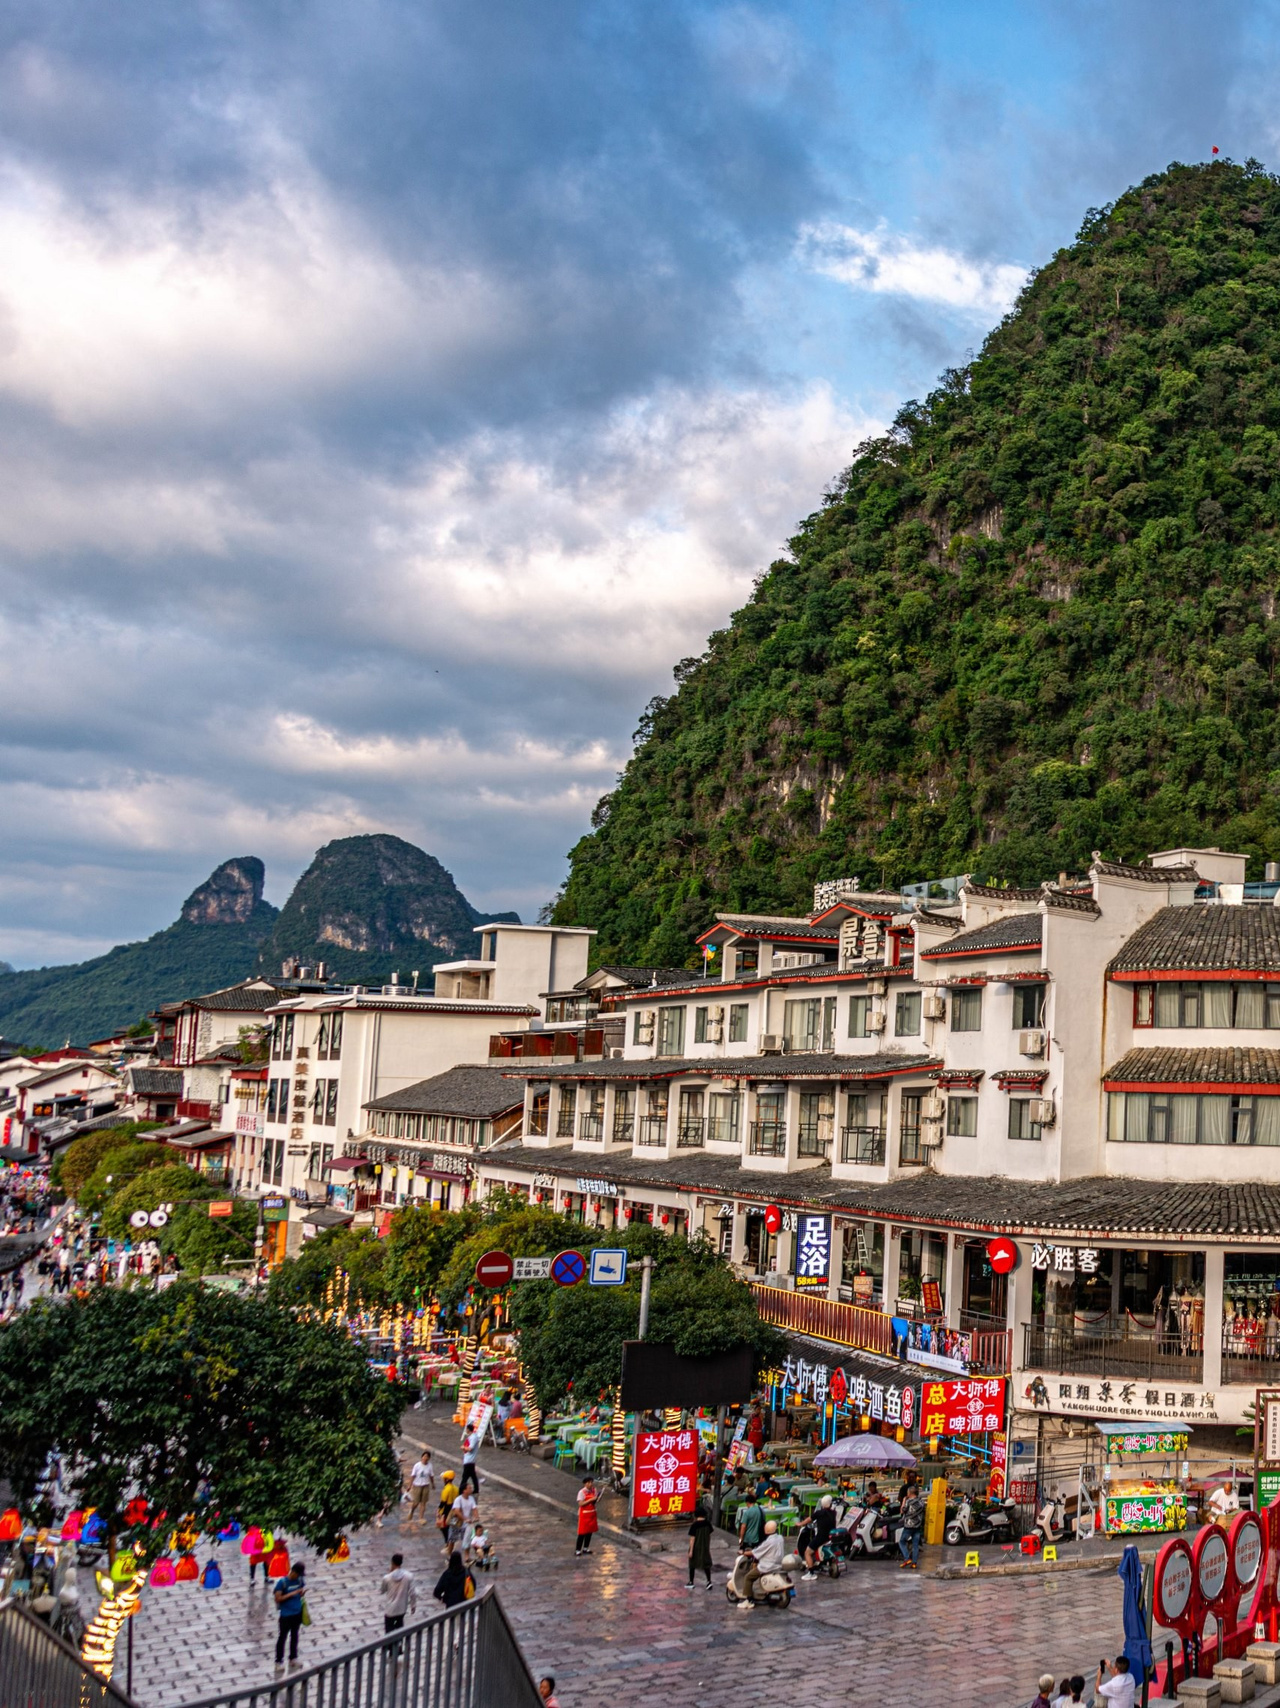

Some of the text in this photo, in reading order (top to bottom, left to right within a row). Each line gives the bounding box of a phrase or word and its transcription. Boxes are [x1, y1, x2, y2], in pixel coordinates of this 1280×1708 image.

[800, 1217, 829, 1276] 足浴
[516, 1260, 549, 1268] 禁止一切
[1031, 1244, 1100, 1273] 必胜客
[779, 1354, 829, 1403] 大师傅
[850, 1374, 902, 1425] 啤酒鱼
[950, 1380, 1001, 1401] 大师傅
[925, 1384, 947, 1434] 总店
[949, 1413, 999, 1433] 啤酒鱼
[642, 1432, 693, 1453] 大师傅
[641, 1476, 690, 1496] 啤酒鱼
[647, 1496, 683, 1514] 总店
